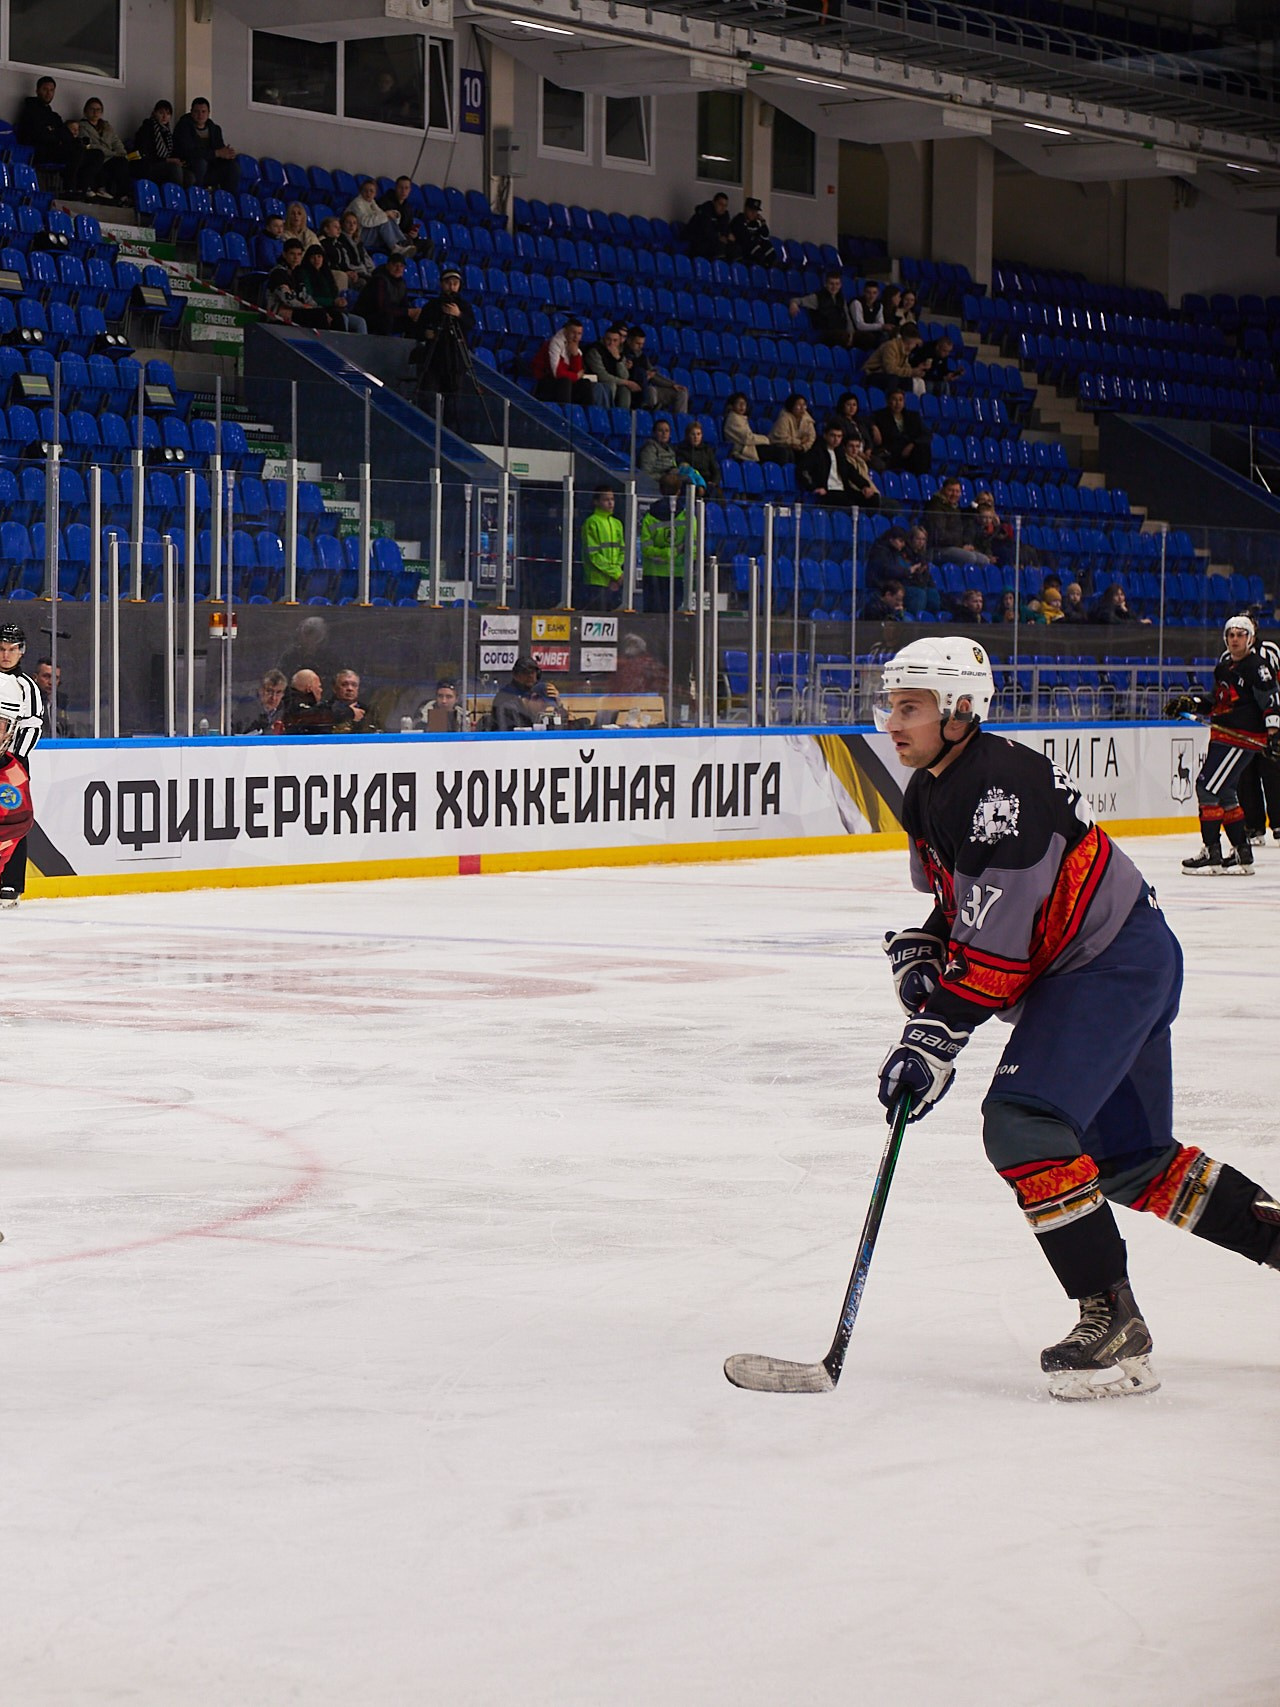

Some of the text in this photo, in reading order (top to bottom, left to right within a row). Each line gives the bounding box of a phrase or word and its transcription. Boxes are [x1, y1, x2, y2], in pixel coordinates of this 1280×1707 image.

[464, 77, 481, 108] 10
[204, 314, 236, 326] SYNERGETIC
[547, 623, 567, 632] БАНК
[583, 622, 615, 637] PARI
[84, 749, 781, 851] ОФИЦЕРСКАЯ ХОККЕЙНАЯ ЛИГА
[961, 884, 1003, 930] 37
[907, 1028, 963, 1055] BAUER
